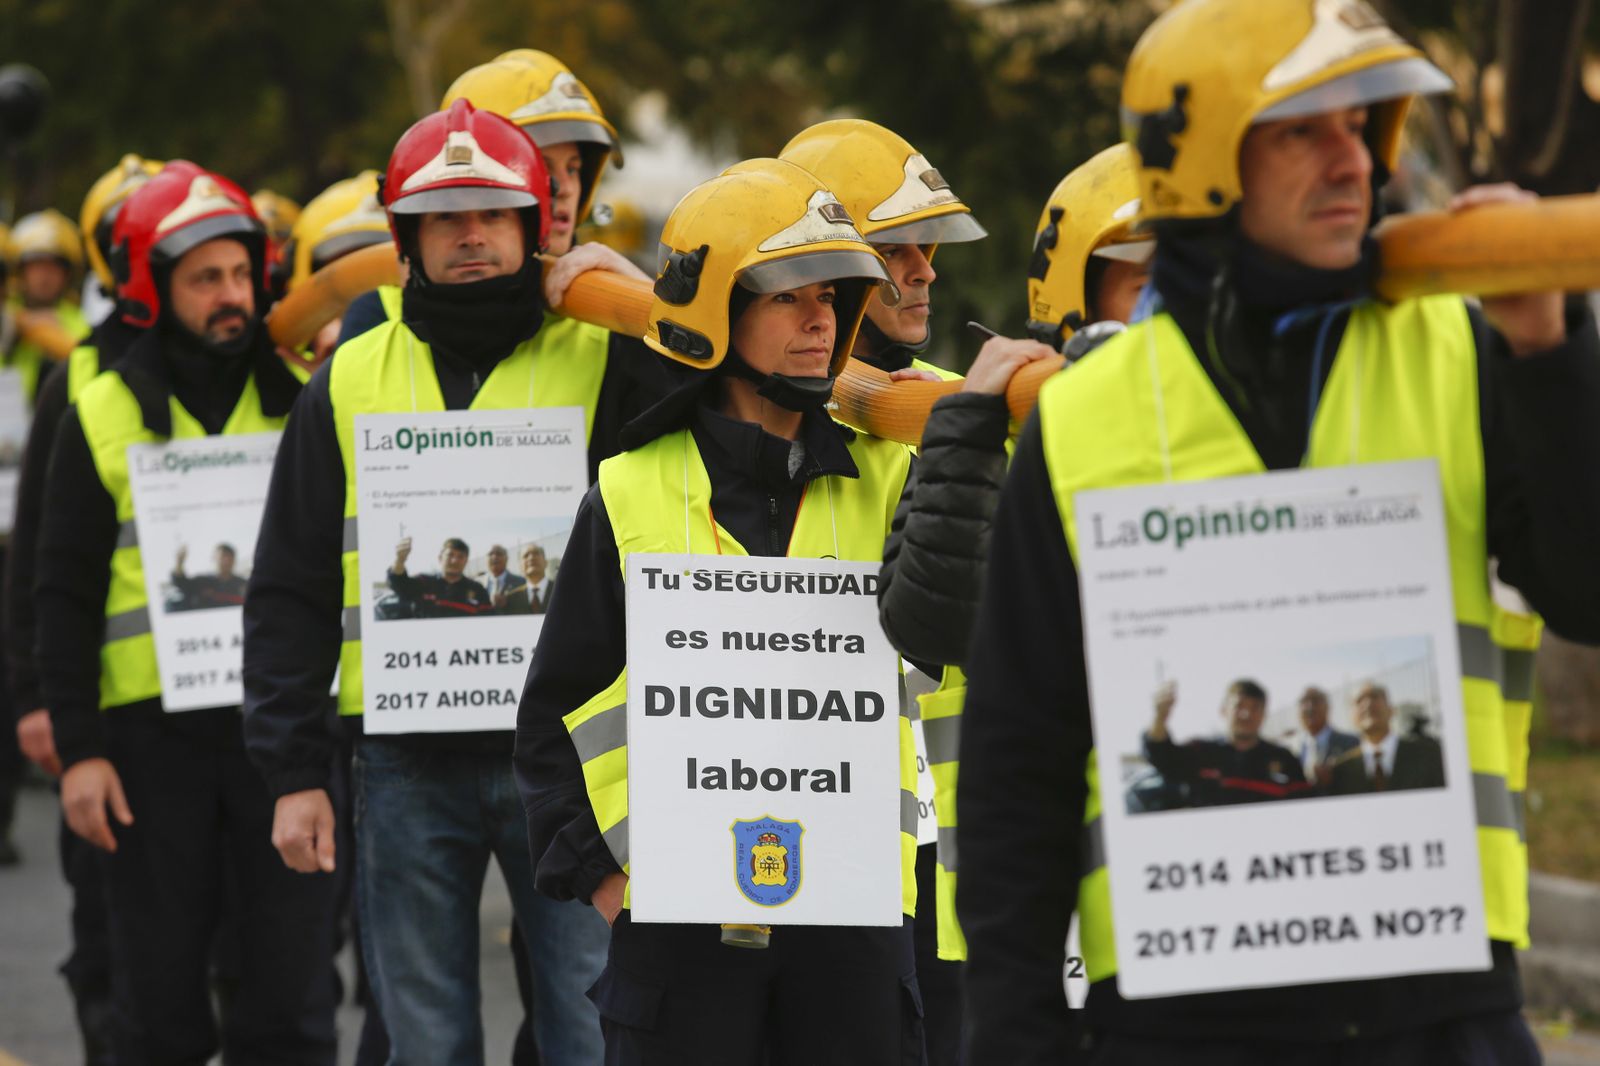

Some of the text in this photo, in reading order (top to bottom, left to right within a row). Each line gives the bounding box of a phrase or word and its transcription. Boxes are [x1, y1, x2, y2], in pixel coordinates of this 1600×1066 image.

[641, 567, 880, 597] Tu SEGURIDAD
[665, 627, 866, 654] es nuestra
[384, 650, 438, 669] 2014
[449, 647, 525, 667] ANTES
[375, 688, 518, 711] 2017 AHORA
[644, 684, 885, 722] DIGNIDAD
[686, 757, 851, 794] laboral
[1145, 859, 1230, 892] 2014
[1246, 846, 1368, 882] ANTES
[1377, 843, 1412, 872] SI
[1136, 904, 1467, 957] 2017 AHORA NO??
